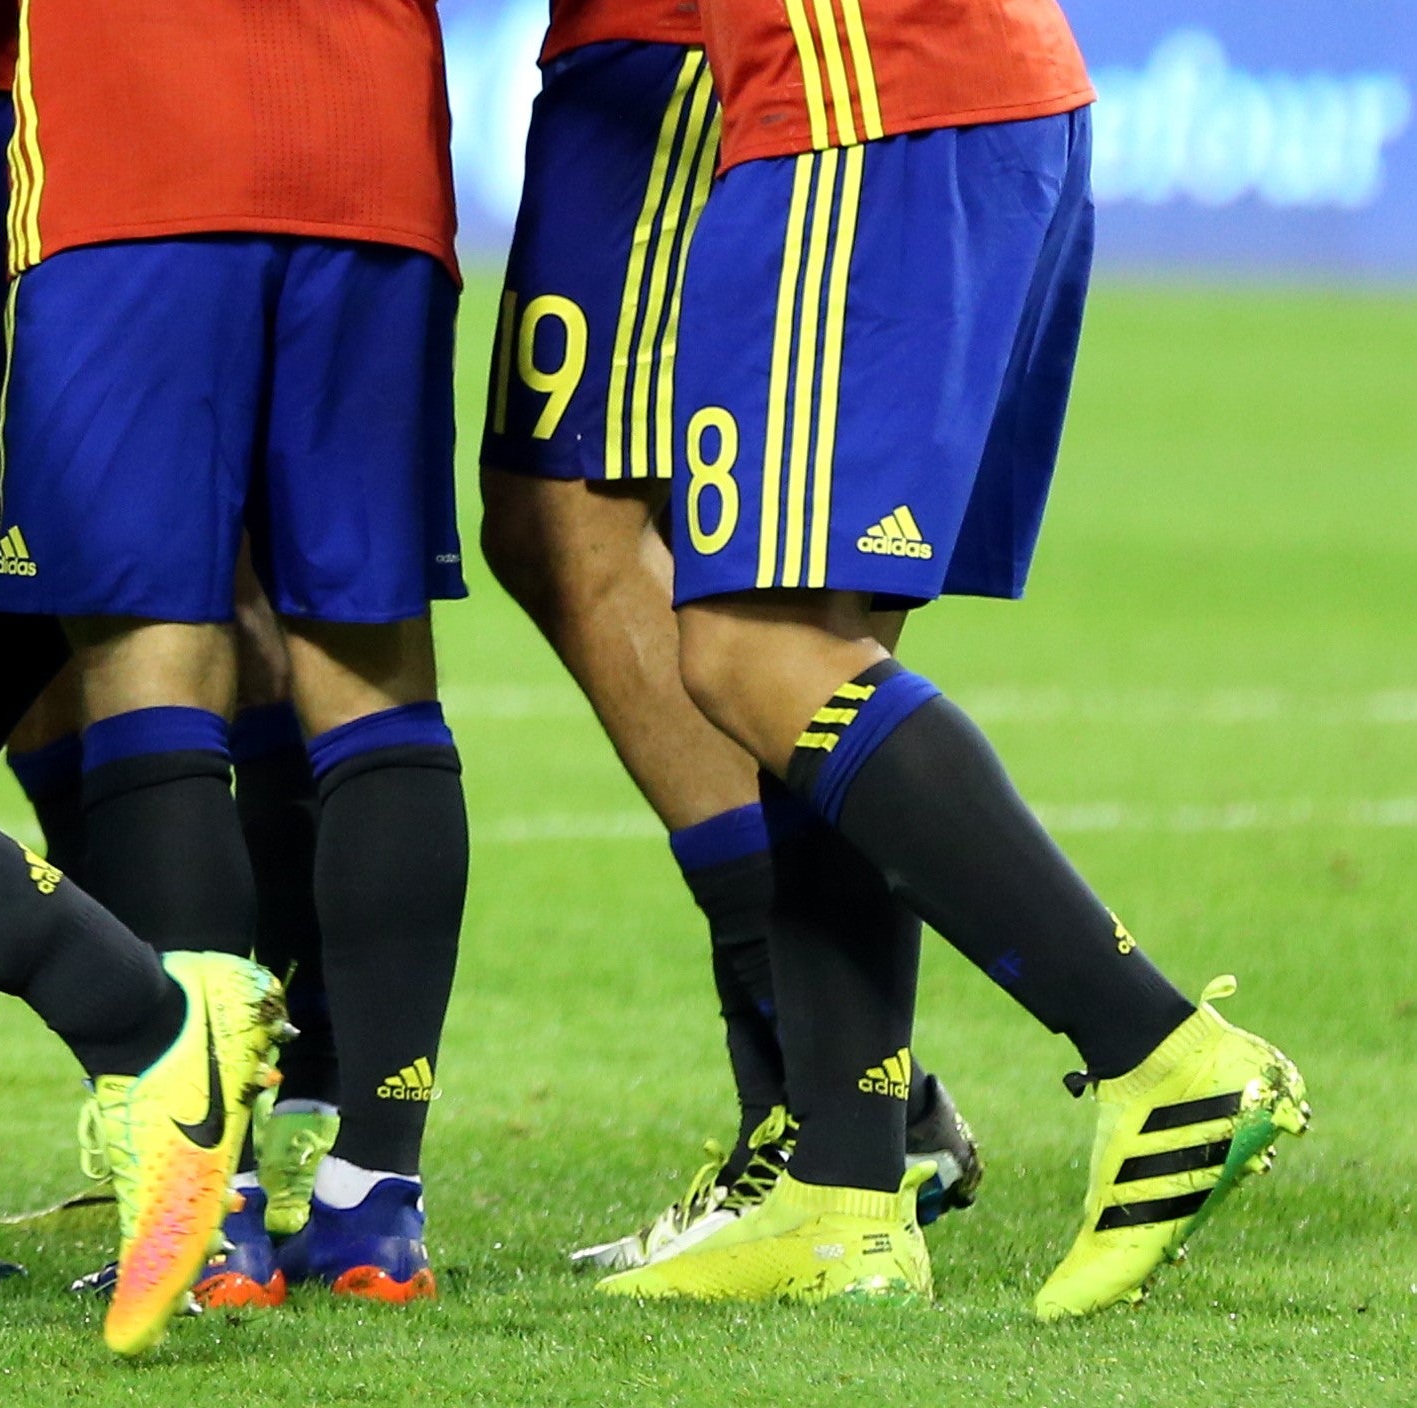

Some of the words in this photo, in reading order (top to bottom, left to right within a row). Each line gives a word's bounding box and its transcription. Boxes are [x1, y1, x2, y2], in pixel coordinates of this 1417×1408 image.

[493, 290, 588, 440] 19
[686, 406, 740, 555] 8
[856, 536, 933, 560] adidas
[376, 1085, 433, 1102] adid
[858, 1077, 910, 1101] adid
